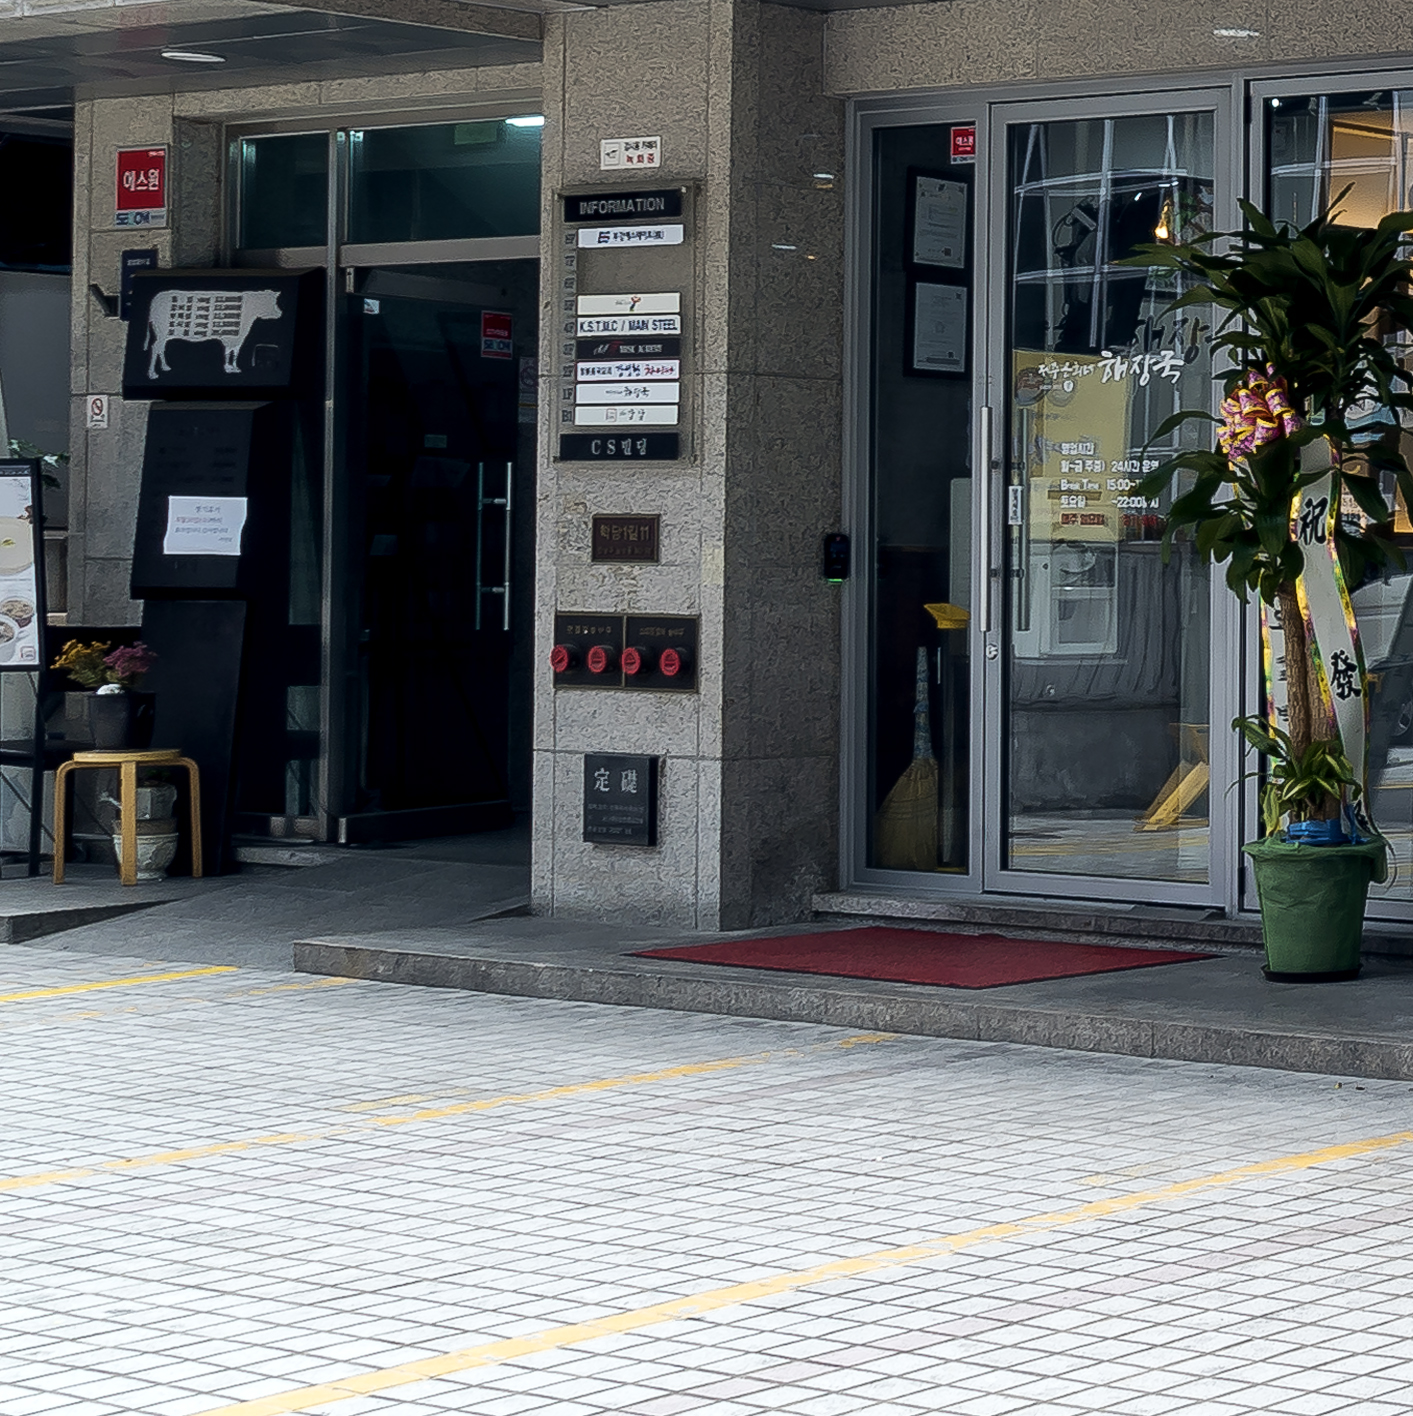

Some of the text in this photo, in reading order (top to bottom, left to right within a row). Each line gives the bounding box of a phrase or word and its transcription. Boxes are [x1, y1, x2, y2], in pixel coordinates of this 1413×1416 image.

[122, 168, 160, 192] 에스원
[579, 197, 665, 216] INFORMATION
[1098, 350, 1185, 387] 해장국
